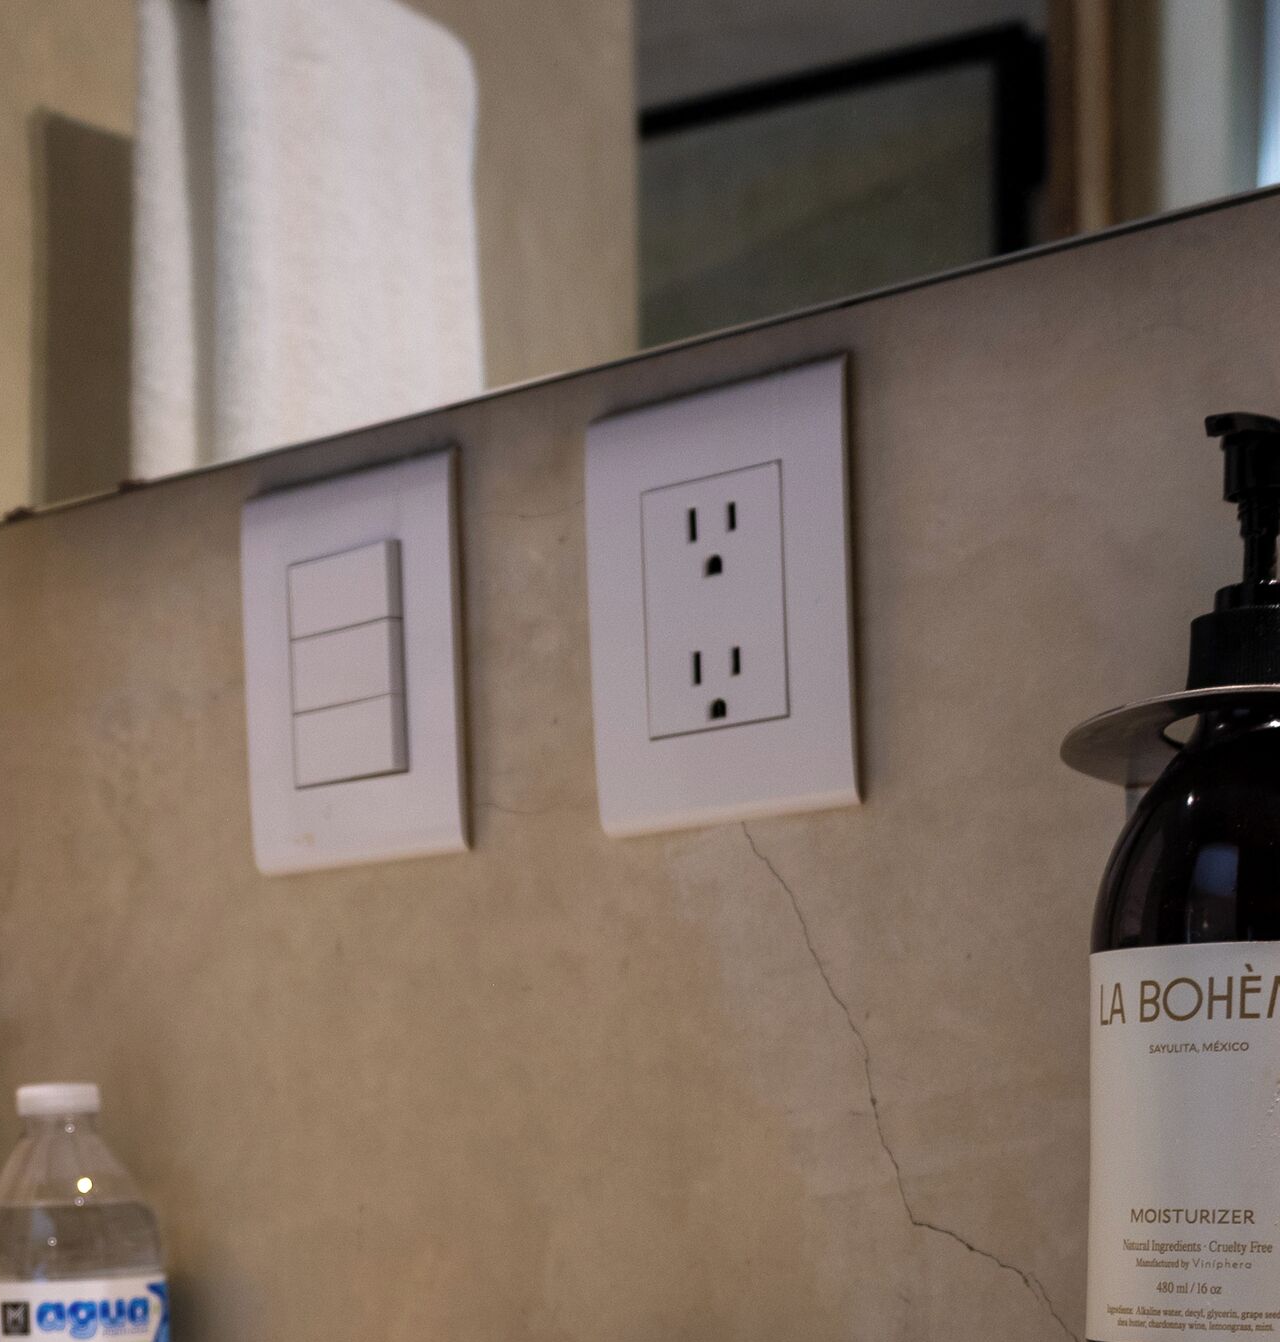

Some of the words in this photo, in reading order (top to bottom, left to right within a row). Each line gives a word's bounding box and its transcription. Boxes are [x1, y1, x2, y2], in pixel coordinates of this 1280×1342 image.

[1099, 982, 1126, 1026] LA
[1148, 1043, 1200, 1055] SAYULITA,
[1202, 1040, 1250, 1053] MÉXICO
[1130, 1208, 1255, 1224] MOISTURIZER
[1123, 1239, 1149, 1251] Natural
[1151, 1240, 1202, 1254] Ingredients
[1208, 1240, 1247, 1255] Cruelty
[1249, 1241, 1273, 1253] Free
[1192, 1258, 1253, 1270] Viniphera
[1156, 1282, 1174, 1294] 480
[1176, 1283, 1188, 1294] ml
[1197, 1283, 1208, 1294] 16
[1210, 1286, 1222, 1295] oz
[36, 1298, 149, 1339] agua
[1241, 1310, 1263, 1320] grape
